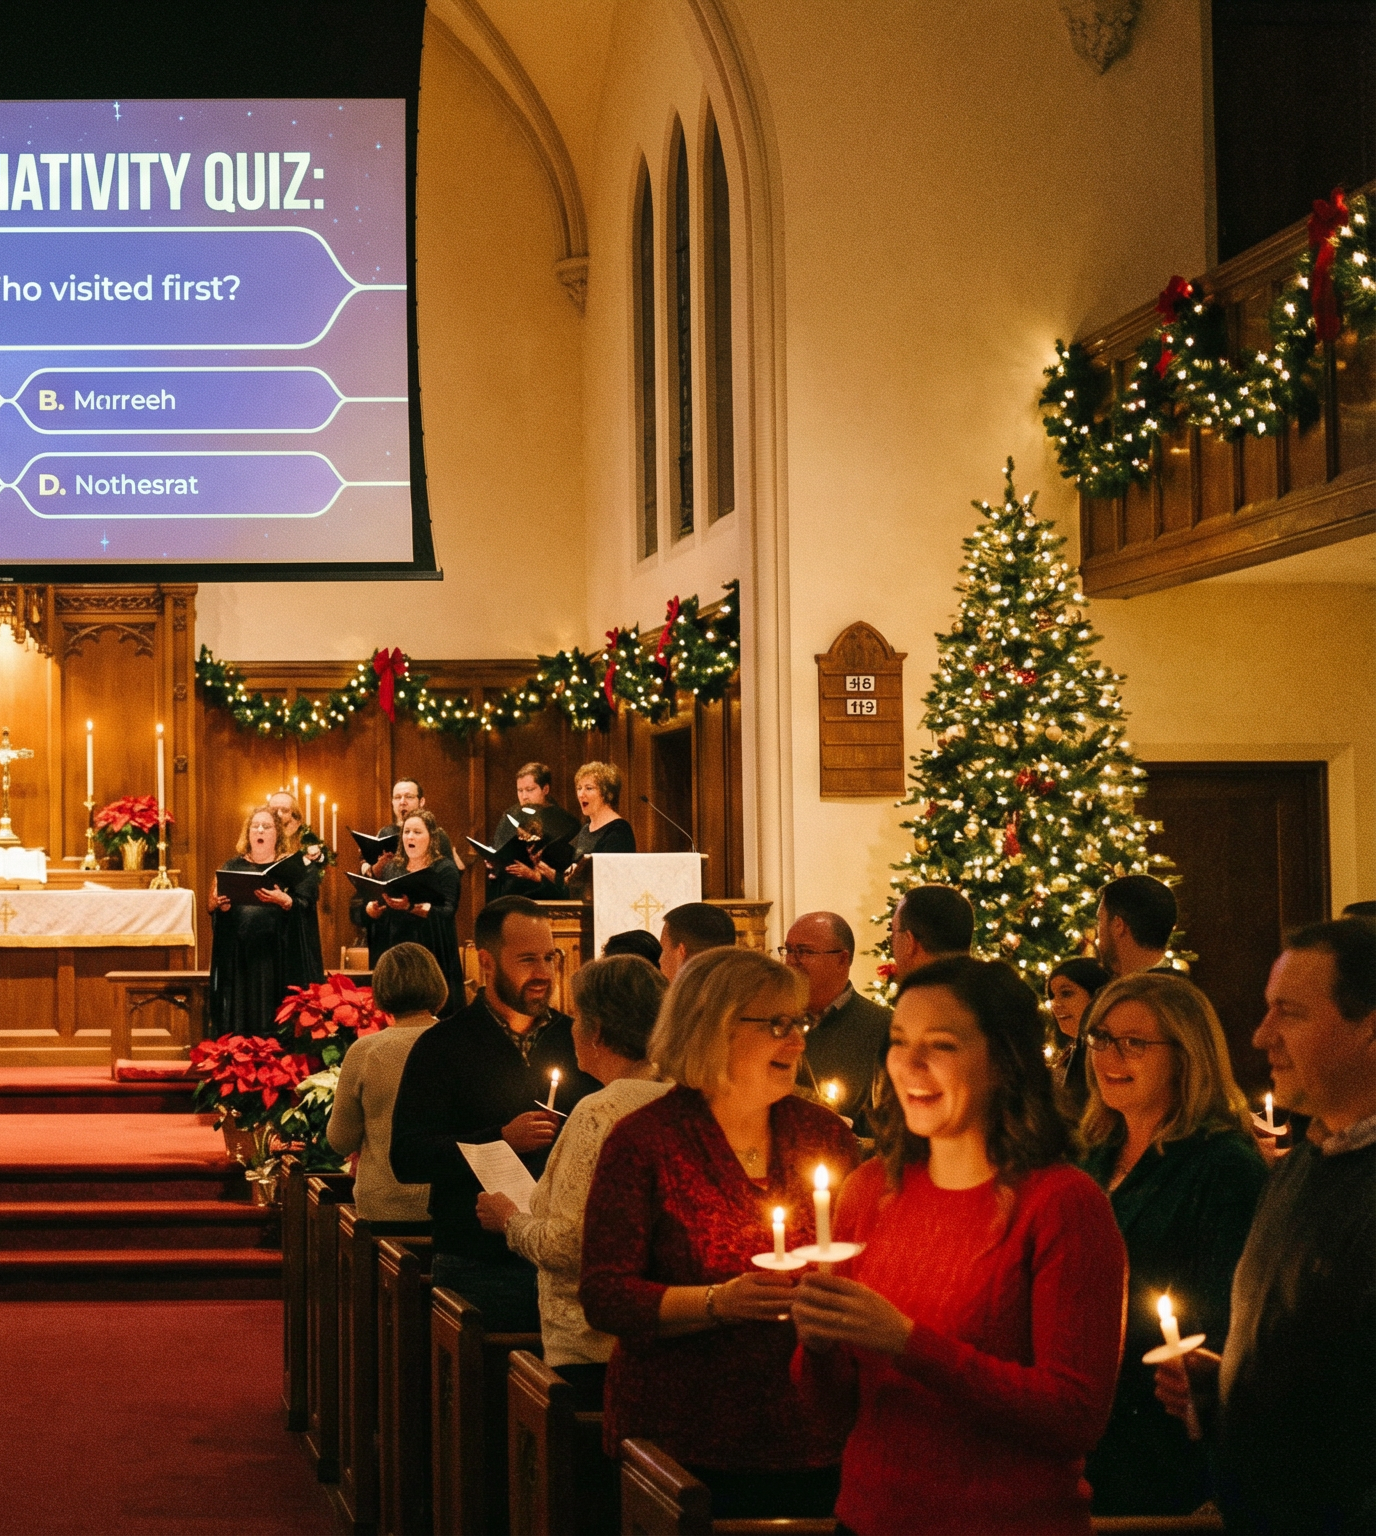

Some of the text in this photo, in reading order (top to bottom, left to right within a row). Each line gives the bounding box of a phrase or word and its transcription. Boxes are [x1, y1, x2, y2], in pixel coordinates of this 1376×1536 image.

[204, 151, 324, 212] QUIZ:
[49, 273, 153, 302] visited
[161, 273, 241, 301] first?
[38, 389, 65, 411] B.
[38, 473, 199, 496] D. Nothesrat
